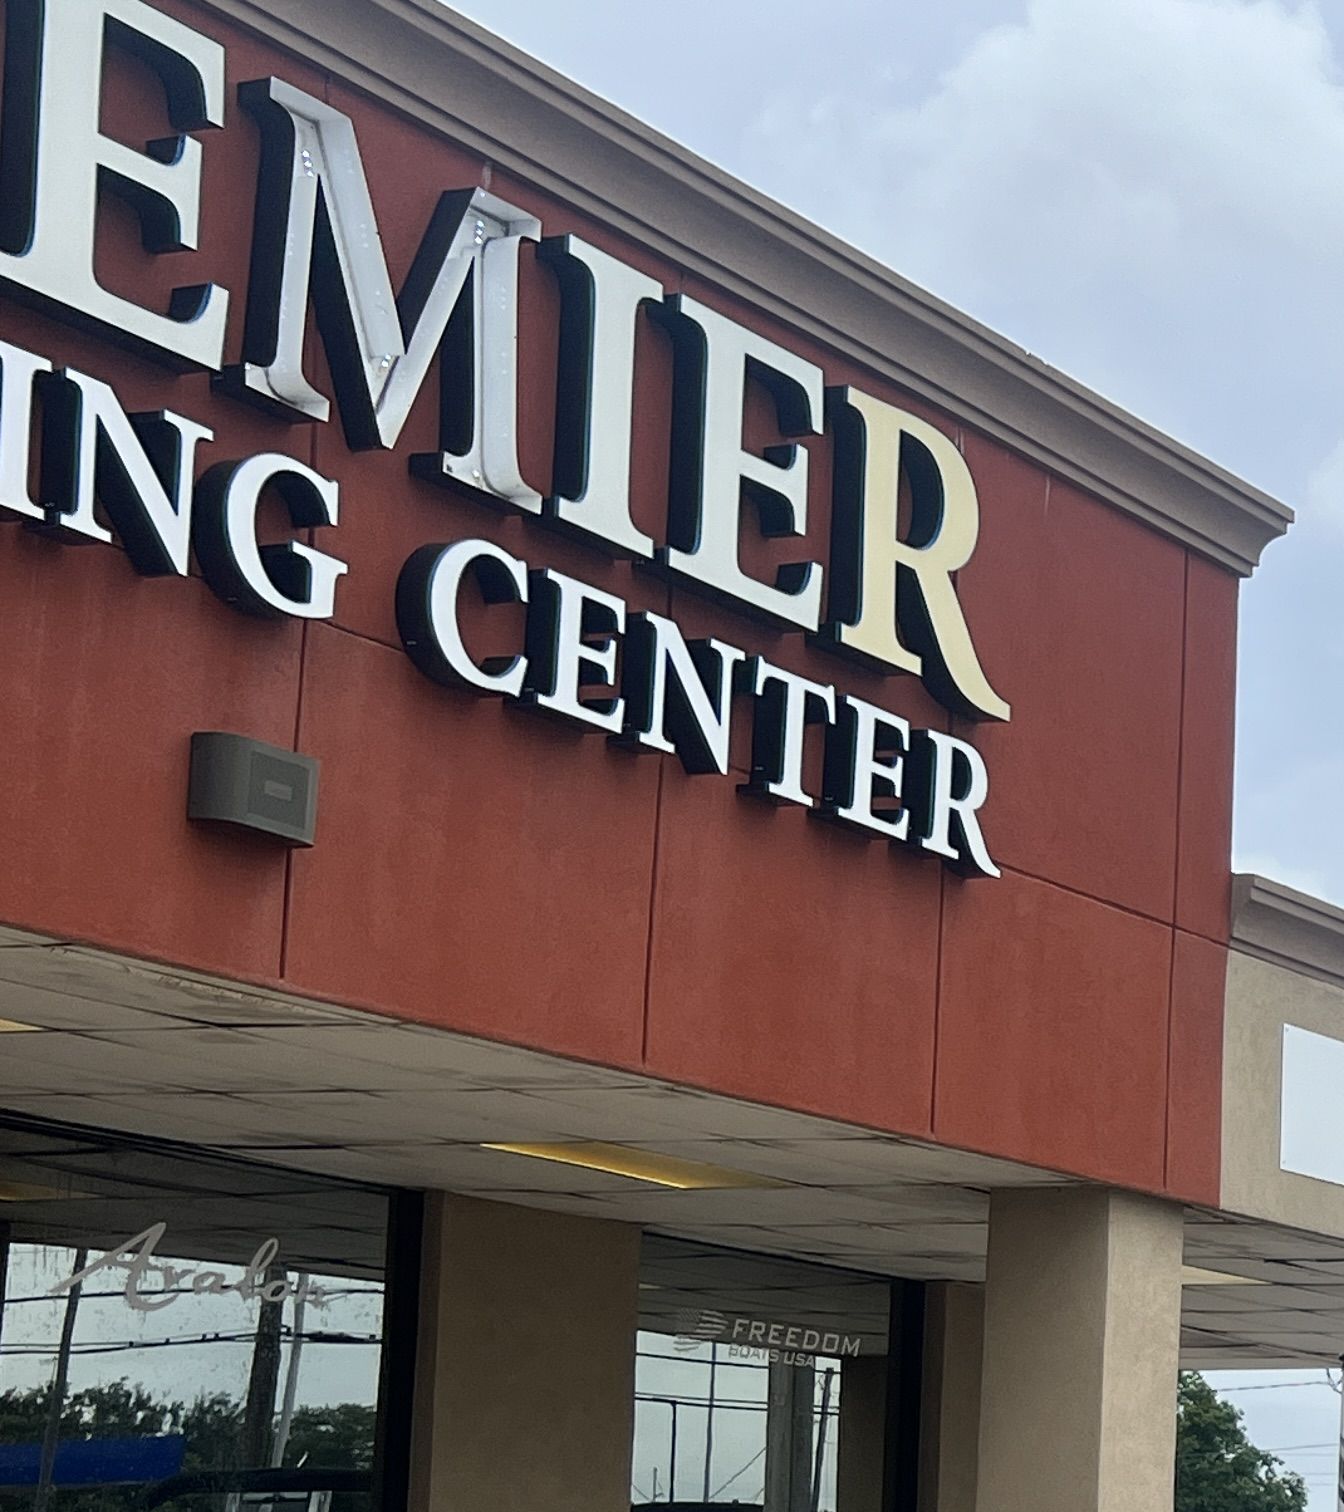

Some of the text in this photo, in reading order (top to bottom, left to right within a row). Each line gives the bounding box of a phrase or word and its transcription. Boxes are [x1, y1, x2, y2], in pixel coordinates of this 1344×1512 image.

[425, 538, 1000, 878] CENTER
[728, 1343, 816, 1368] BOATS USA
[732, 1318, 861, 1358] FREEDOM
